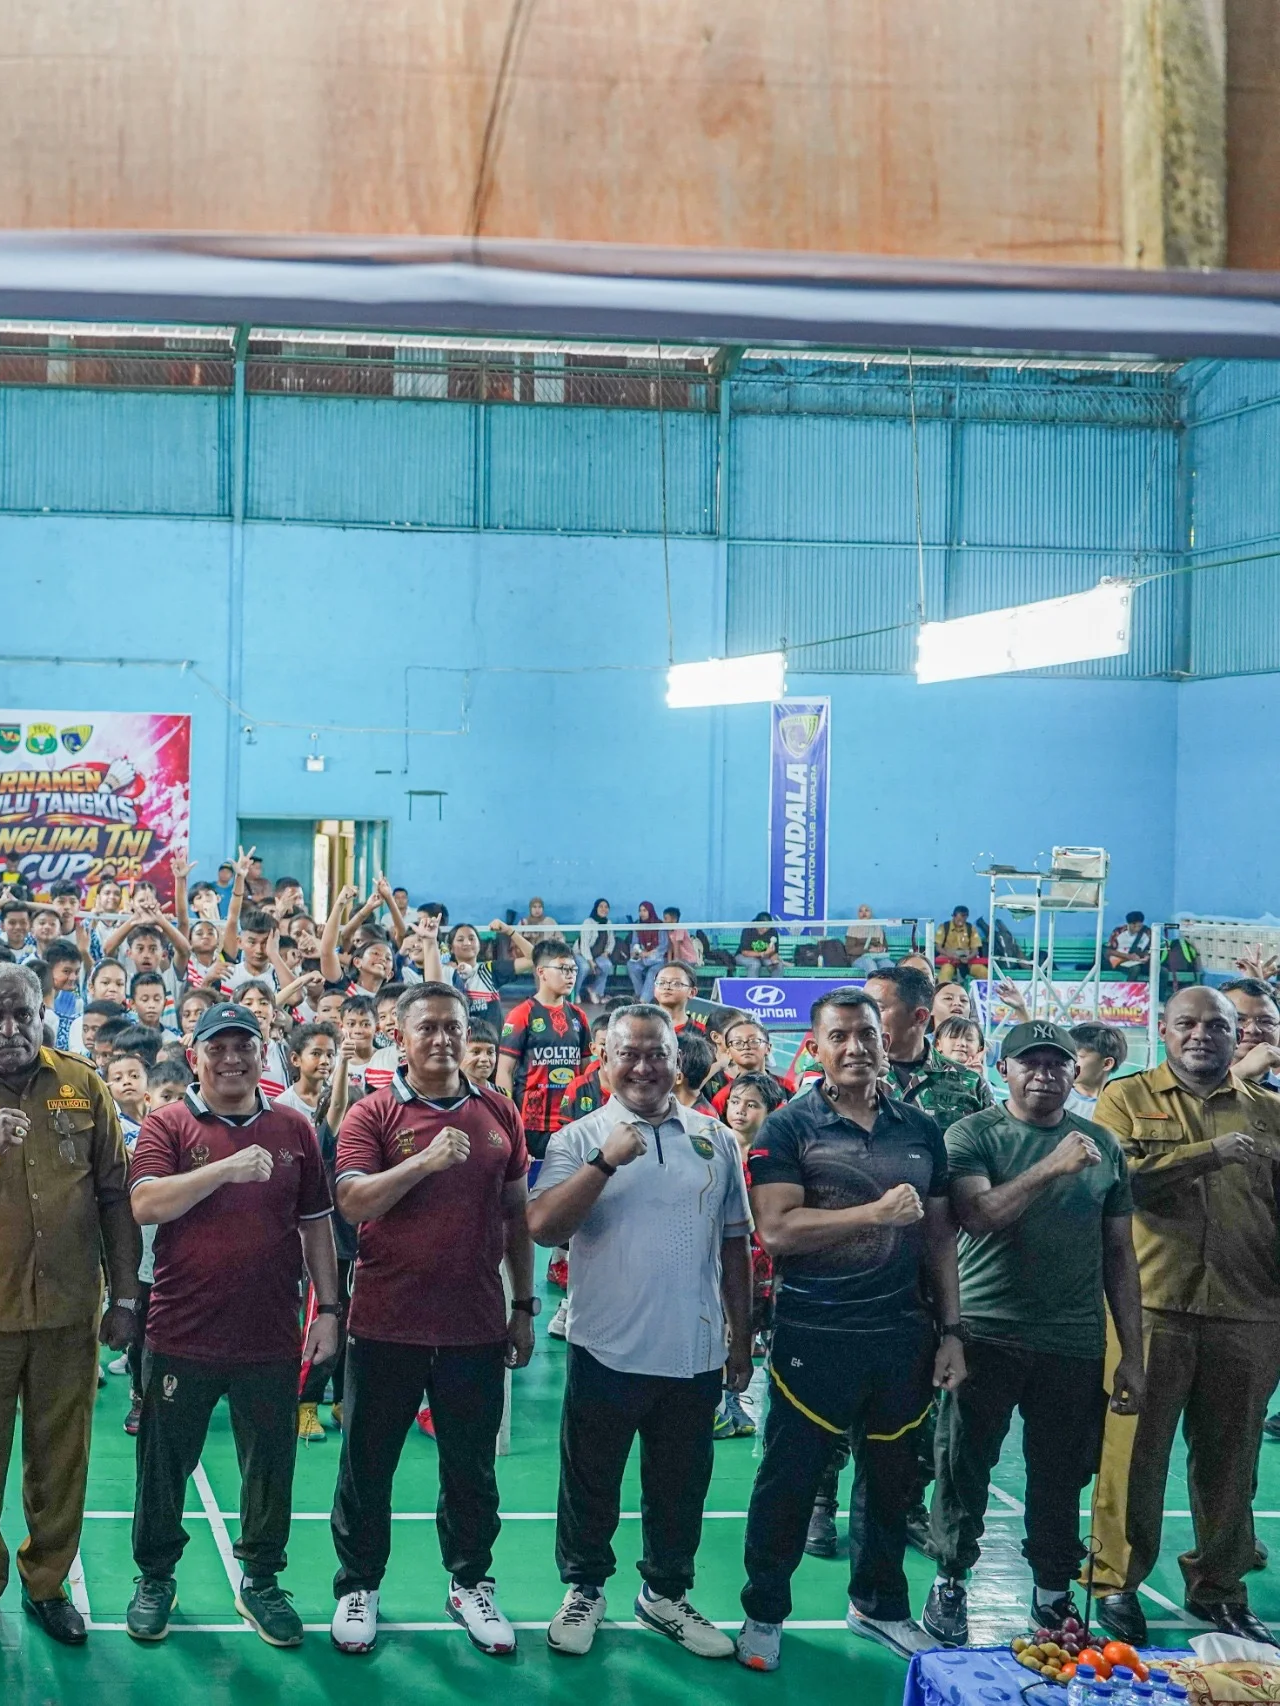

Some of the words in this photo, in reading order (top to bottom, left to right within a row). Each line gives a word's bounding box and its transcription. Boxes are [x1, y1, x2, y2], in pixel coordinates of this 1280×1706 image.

[33, 792, 138, 826] TANGKIS
[809, 765, 817, 820] JAYAPURA
[103, 824, 153, 862] TNI
[783, 763, 808, 917] MANDALA
[19, 853, 94, 881] CUP
[808, 854, 816, 917] BADMINTON
[746, 1008, 798, 1019] YUNDAI
